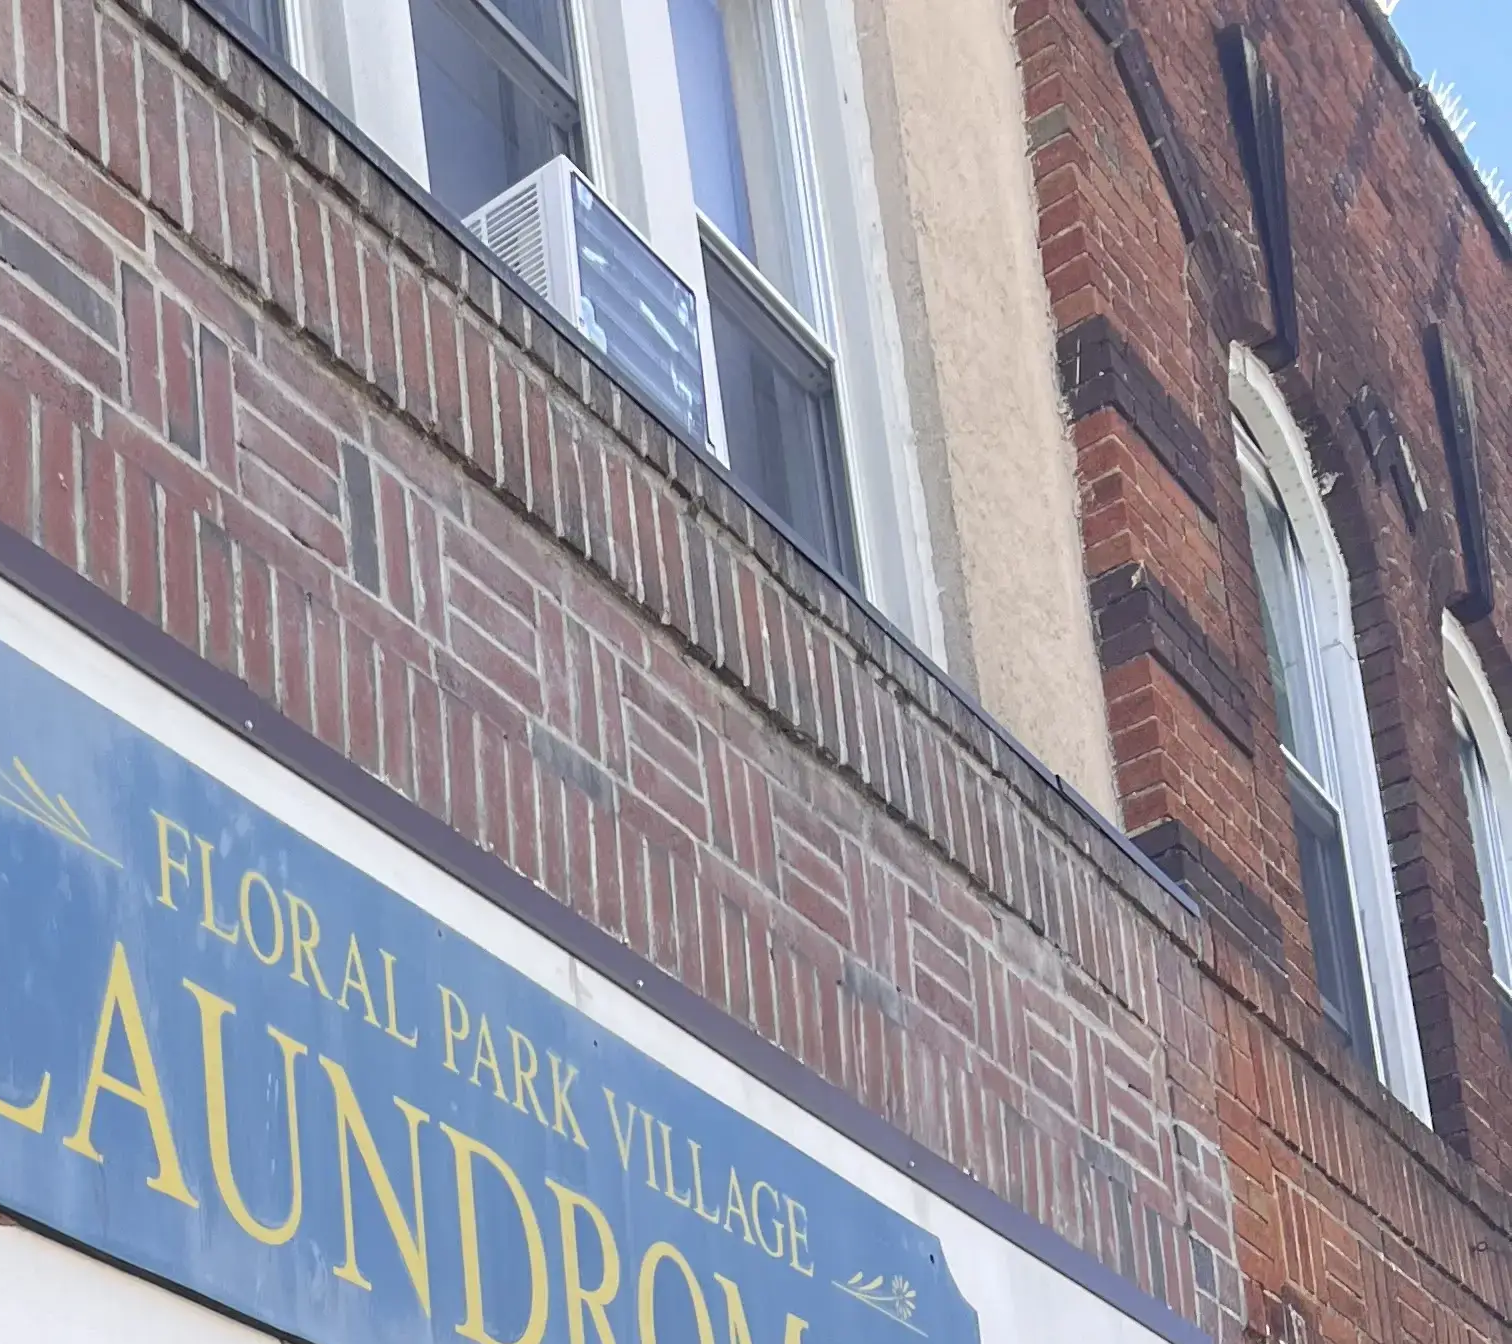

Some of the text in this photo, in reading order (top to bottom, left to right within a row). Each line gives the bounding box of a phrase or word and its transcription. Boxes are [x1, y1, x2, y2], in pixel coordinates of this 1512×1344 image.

[151, 811, 816, 1280] FLORAL PARK VILLAGE
